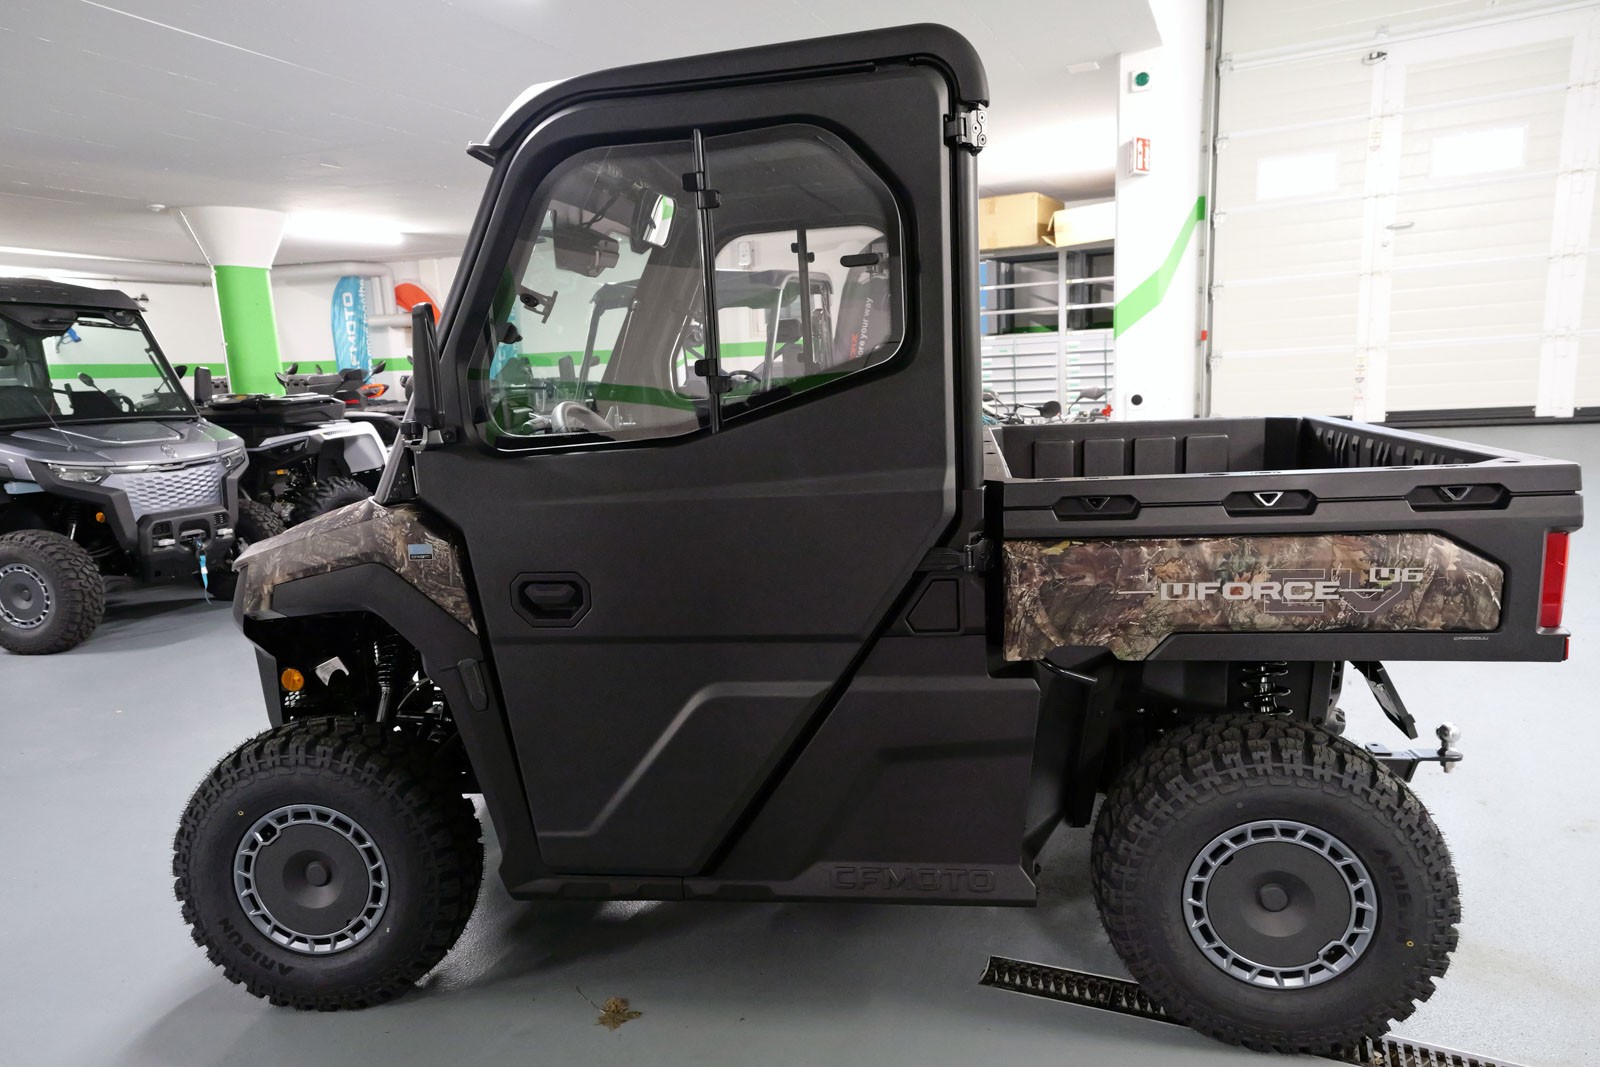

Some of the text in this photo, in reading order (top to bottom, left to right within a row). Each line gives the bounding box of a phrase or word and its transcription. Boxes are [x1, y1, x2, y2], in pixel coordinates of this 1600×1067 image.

[342, 292, 360, 369] FMOTO
[860, 318, 868, 340] your
[864, 297, 873, 317] way
[830, 866, 996, 893] CFMOTO
[219, 918, 294, 975] ARISUN
